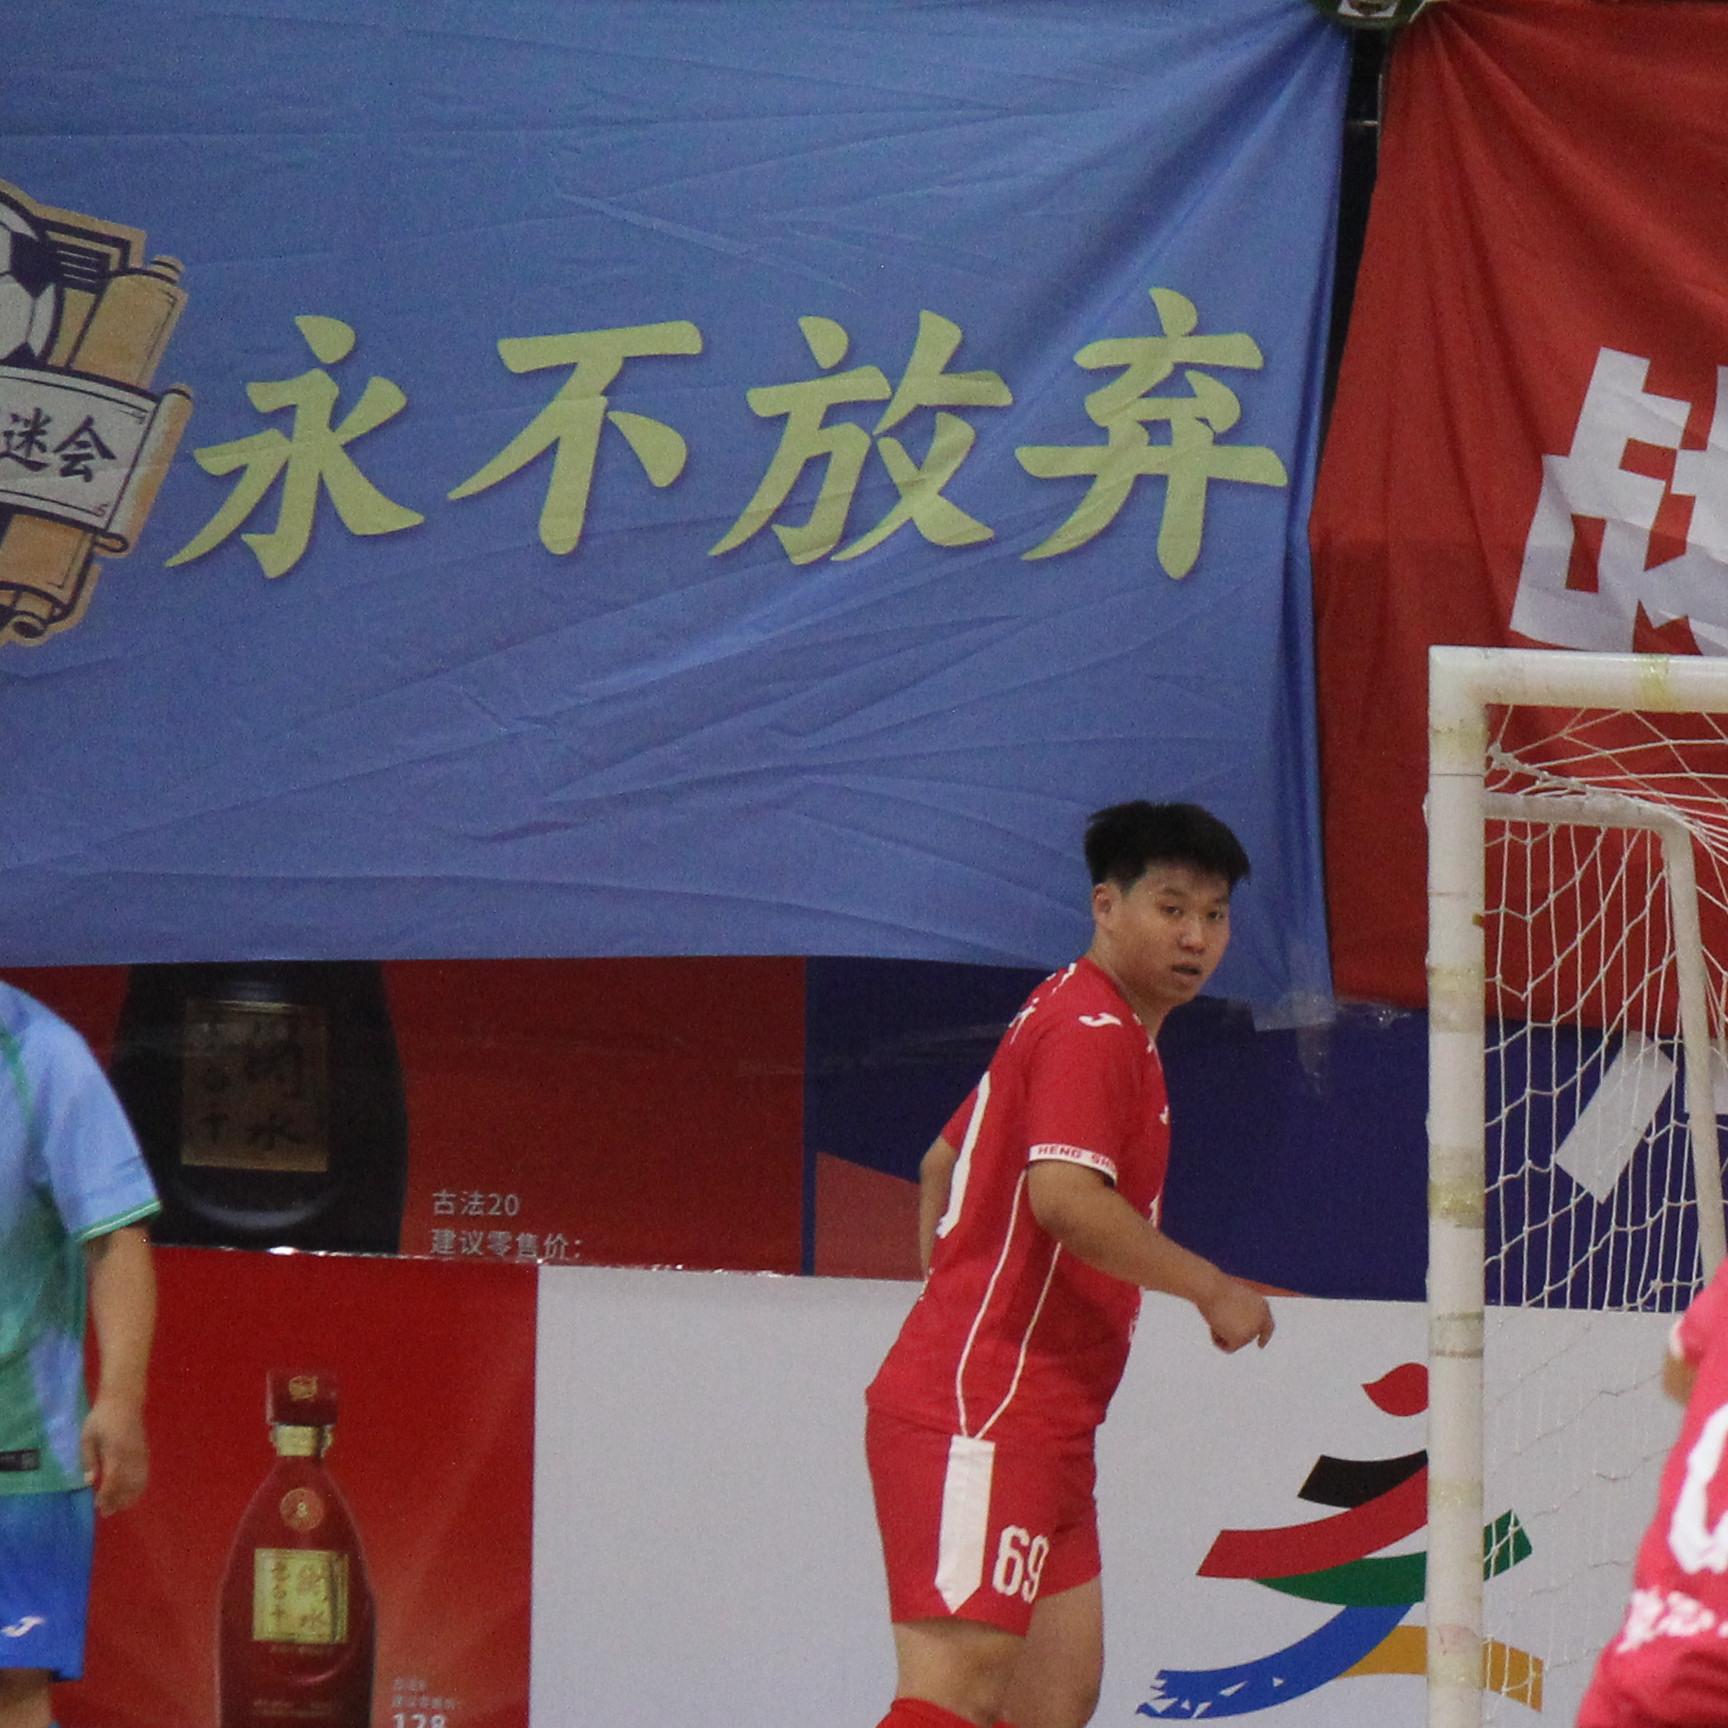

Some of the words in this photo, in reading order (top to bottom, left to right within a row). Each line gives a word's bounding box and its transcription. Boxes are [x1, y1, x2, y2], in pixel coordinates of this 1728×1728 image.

[164, 288, 1288, 579] 永不放弃
[432, 1189, 520, 1217] 古法20
[992, 1525, 1049, 1604] 69
